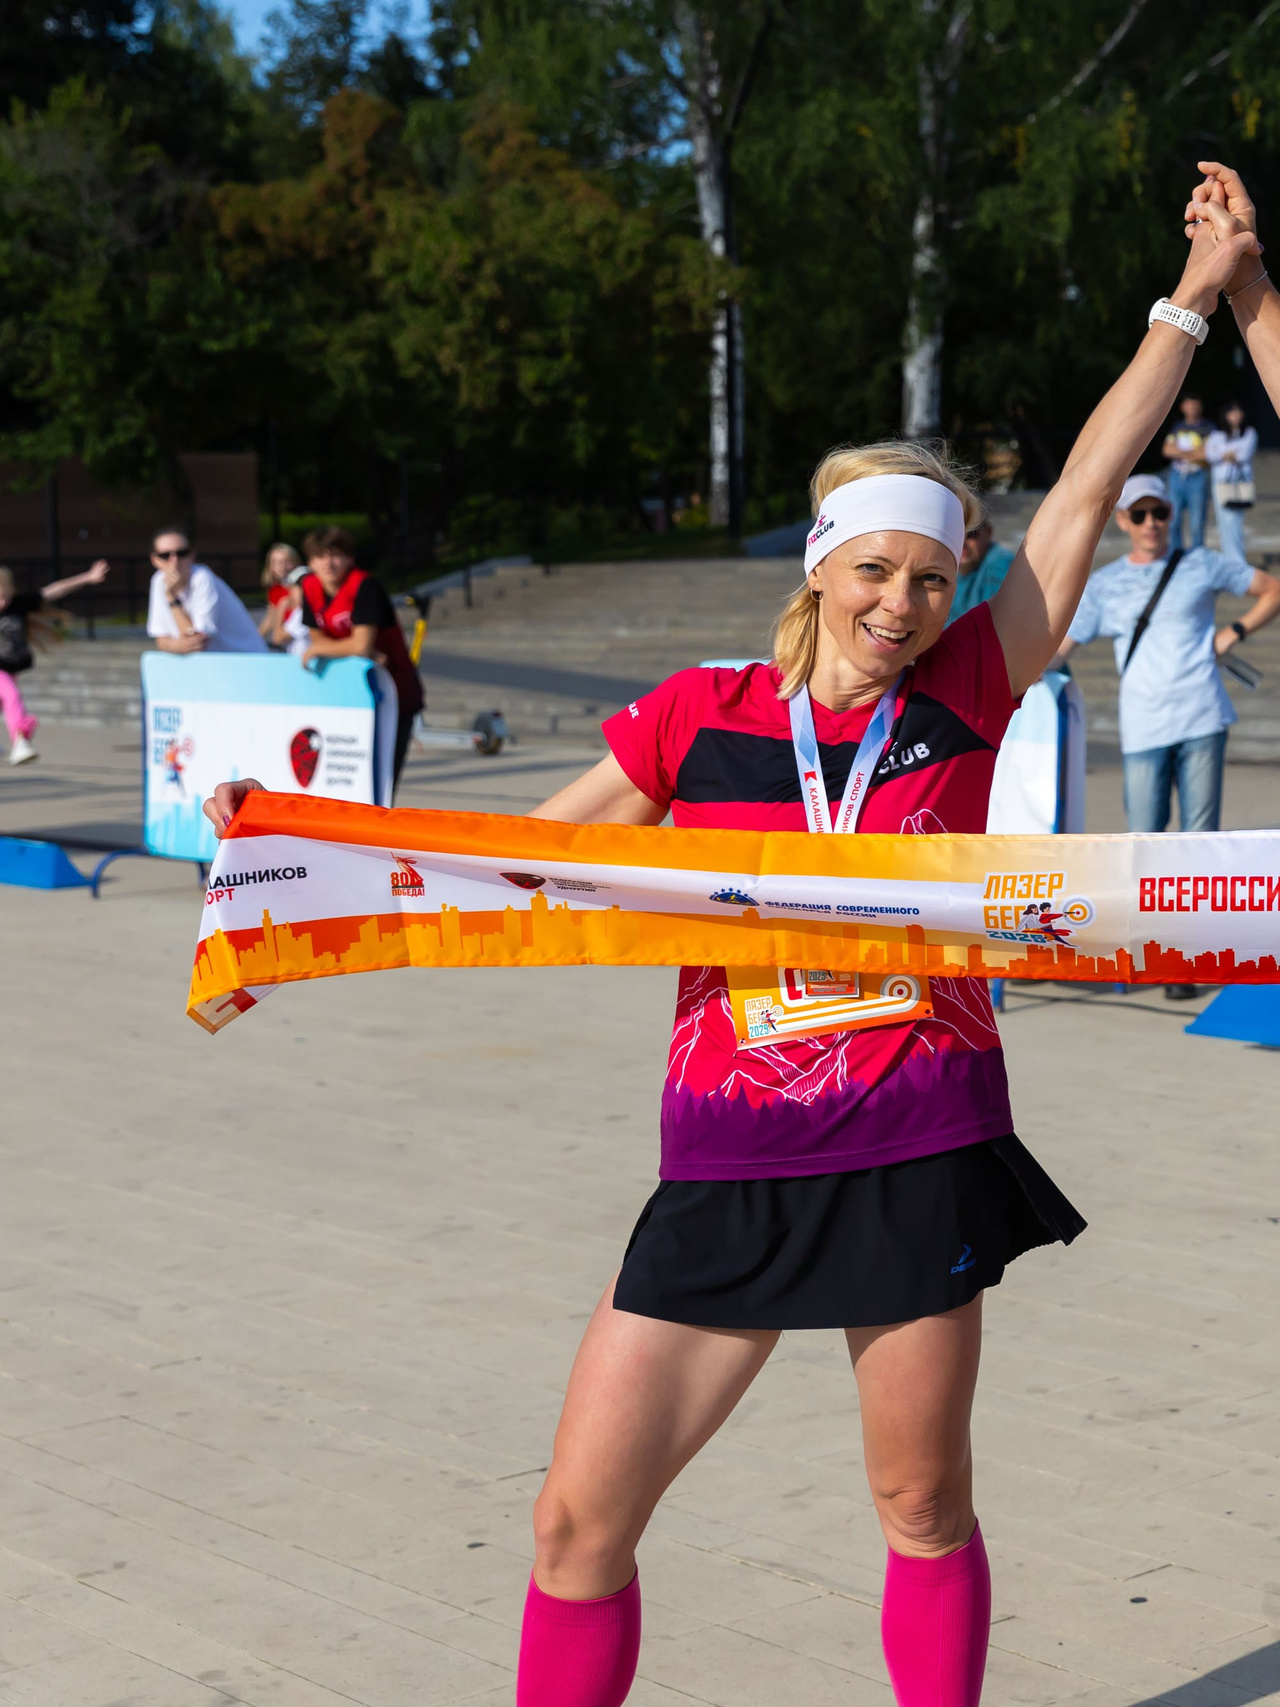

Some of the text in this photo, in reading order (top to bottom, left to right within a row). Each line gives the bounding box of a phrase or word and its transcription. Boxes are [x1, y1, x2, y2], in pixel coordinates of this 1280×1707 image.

[850, 771, 865, 801] СПОРТ
[390, 871, 412, 887] 80
[983, 873, 1064, 899] ЛАЗЕР
[204, 888, 235, 907] ОРТ
[391, 887, 425, 898] ПОБЕДА!
[764, 900, 920, 916] ФЕДЕРАЦИЯ СОВРЕМЕННОГО
[983, 905, 1027, 930] БЕГ
[985, 930, 1047, 944] 2025
[745, 996, 772, 1013] ЛАЗЕР
[749, 1023, 770, 1038] 2025
